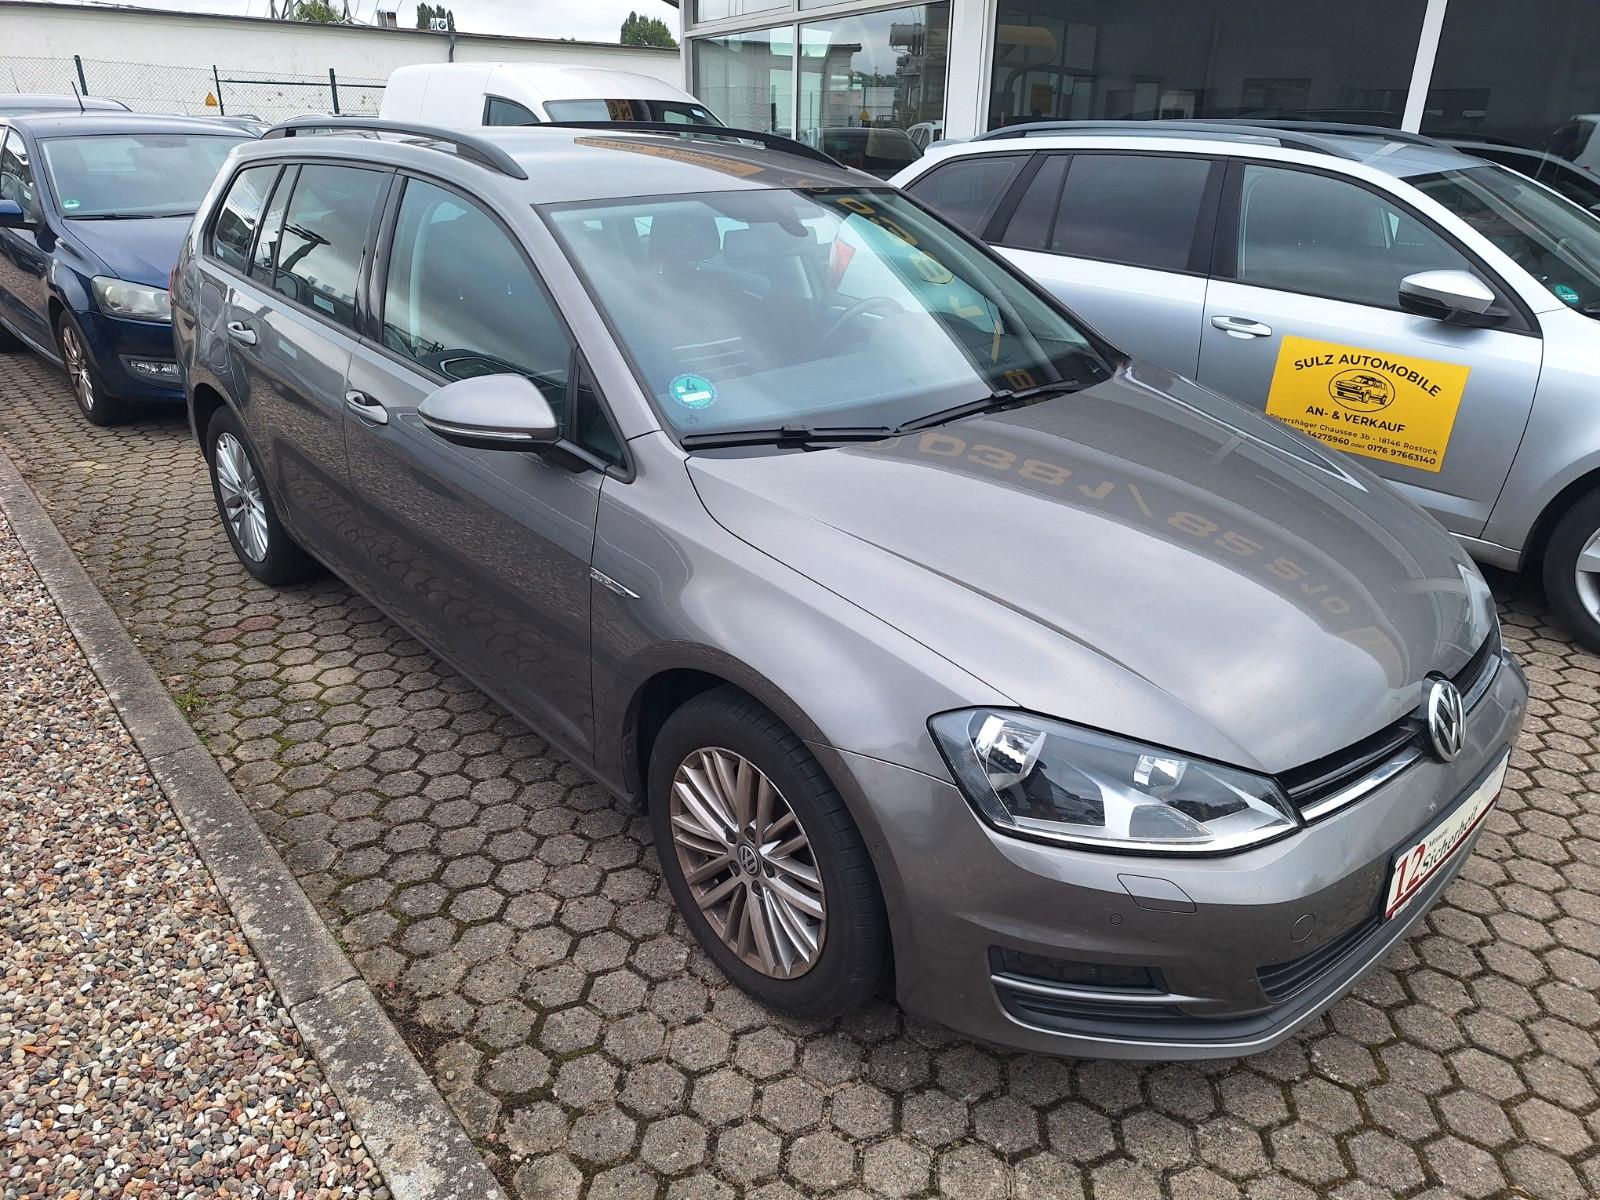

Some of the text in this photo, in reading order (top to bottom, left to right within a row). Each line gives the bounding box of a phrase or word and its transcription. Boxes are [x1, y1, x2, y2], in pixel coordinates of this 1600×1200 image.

[1294, 354, 1442, 397] SULZ AUTOMOBILE
[1306, 405, 1407, 432] AN- & VERKAUF
[1319, 424, 1358, 438] Chaussee
[1360, 432, 1371, 440] 3b
[1379, 437, 1401, 447] 18146
[1403, 442, 1438, 455] Rostock
[1367, 443, 1388, 454] 0176
[1390, 448, 1436, 465] 97663140
[1392, 843, 1426, 905] 12
